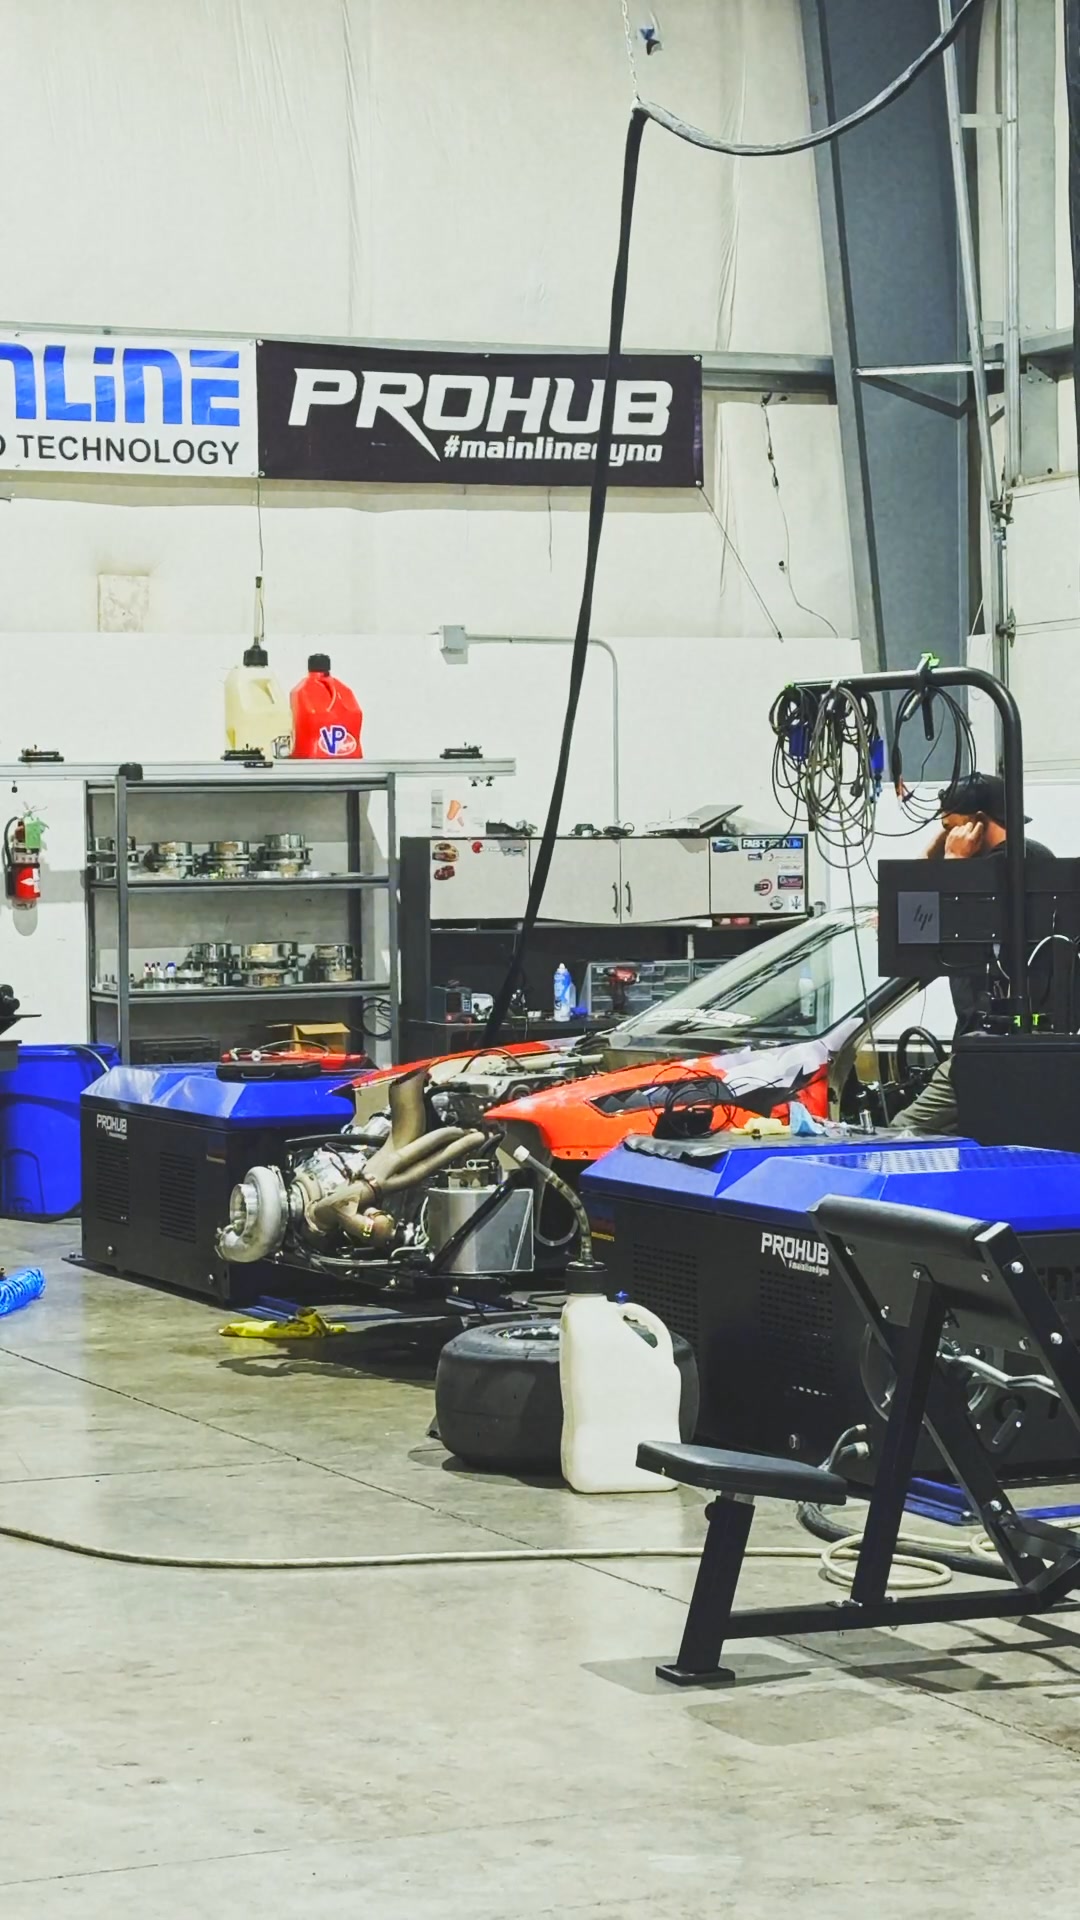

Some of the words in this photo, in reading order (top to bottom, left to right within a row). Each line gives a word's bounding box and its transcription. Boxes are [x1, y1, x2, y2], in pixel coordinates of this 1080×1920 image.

[288, 368, 673, 462] PROHUB
[17, 434, 239, 465] TECHNOLOGY
[320, 725, 347, 755] VP
[97, 1113, 128, 1136] PROHUB
[761, 1232, 829, 1267] PROHUB
